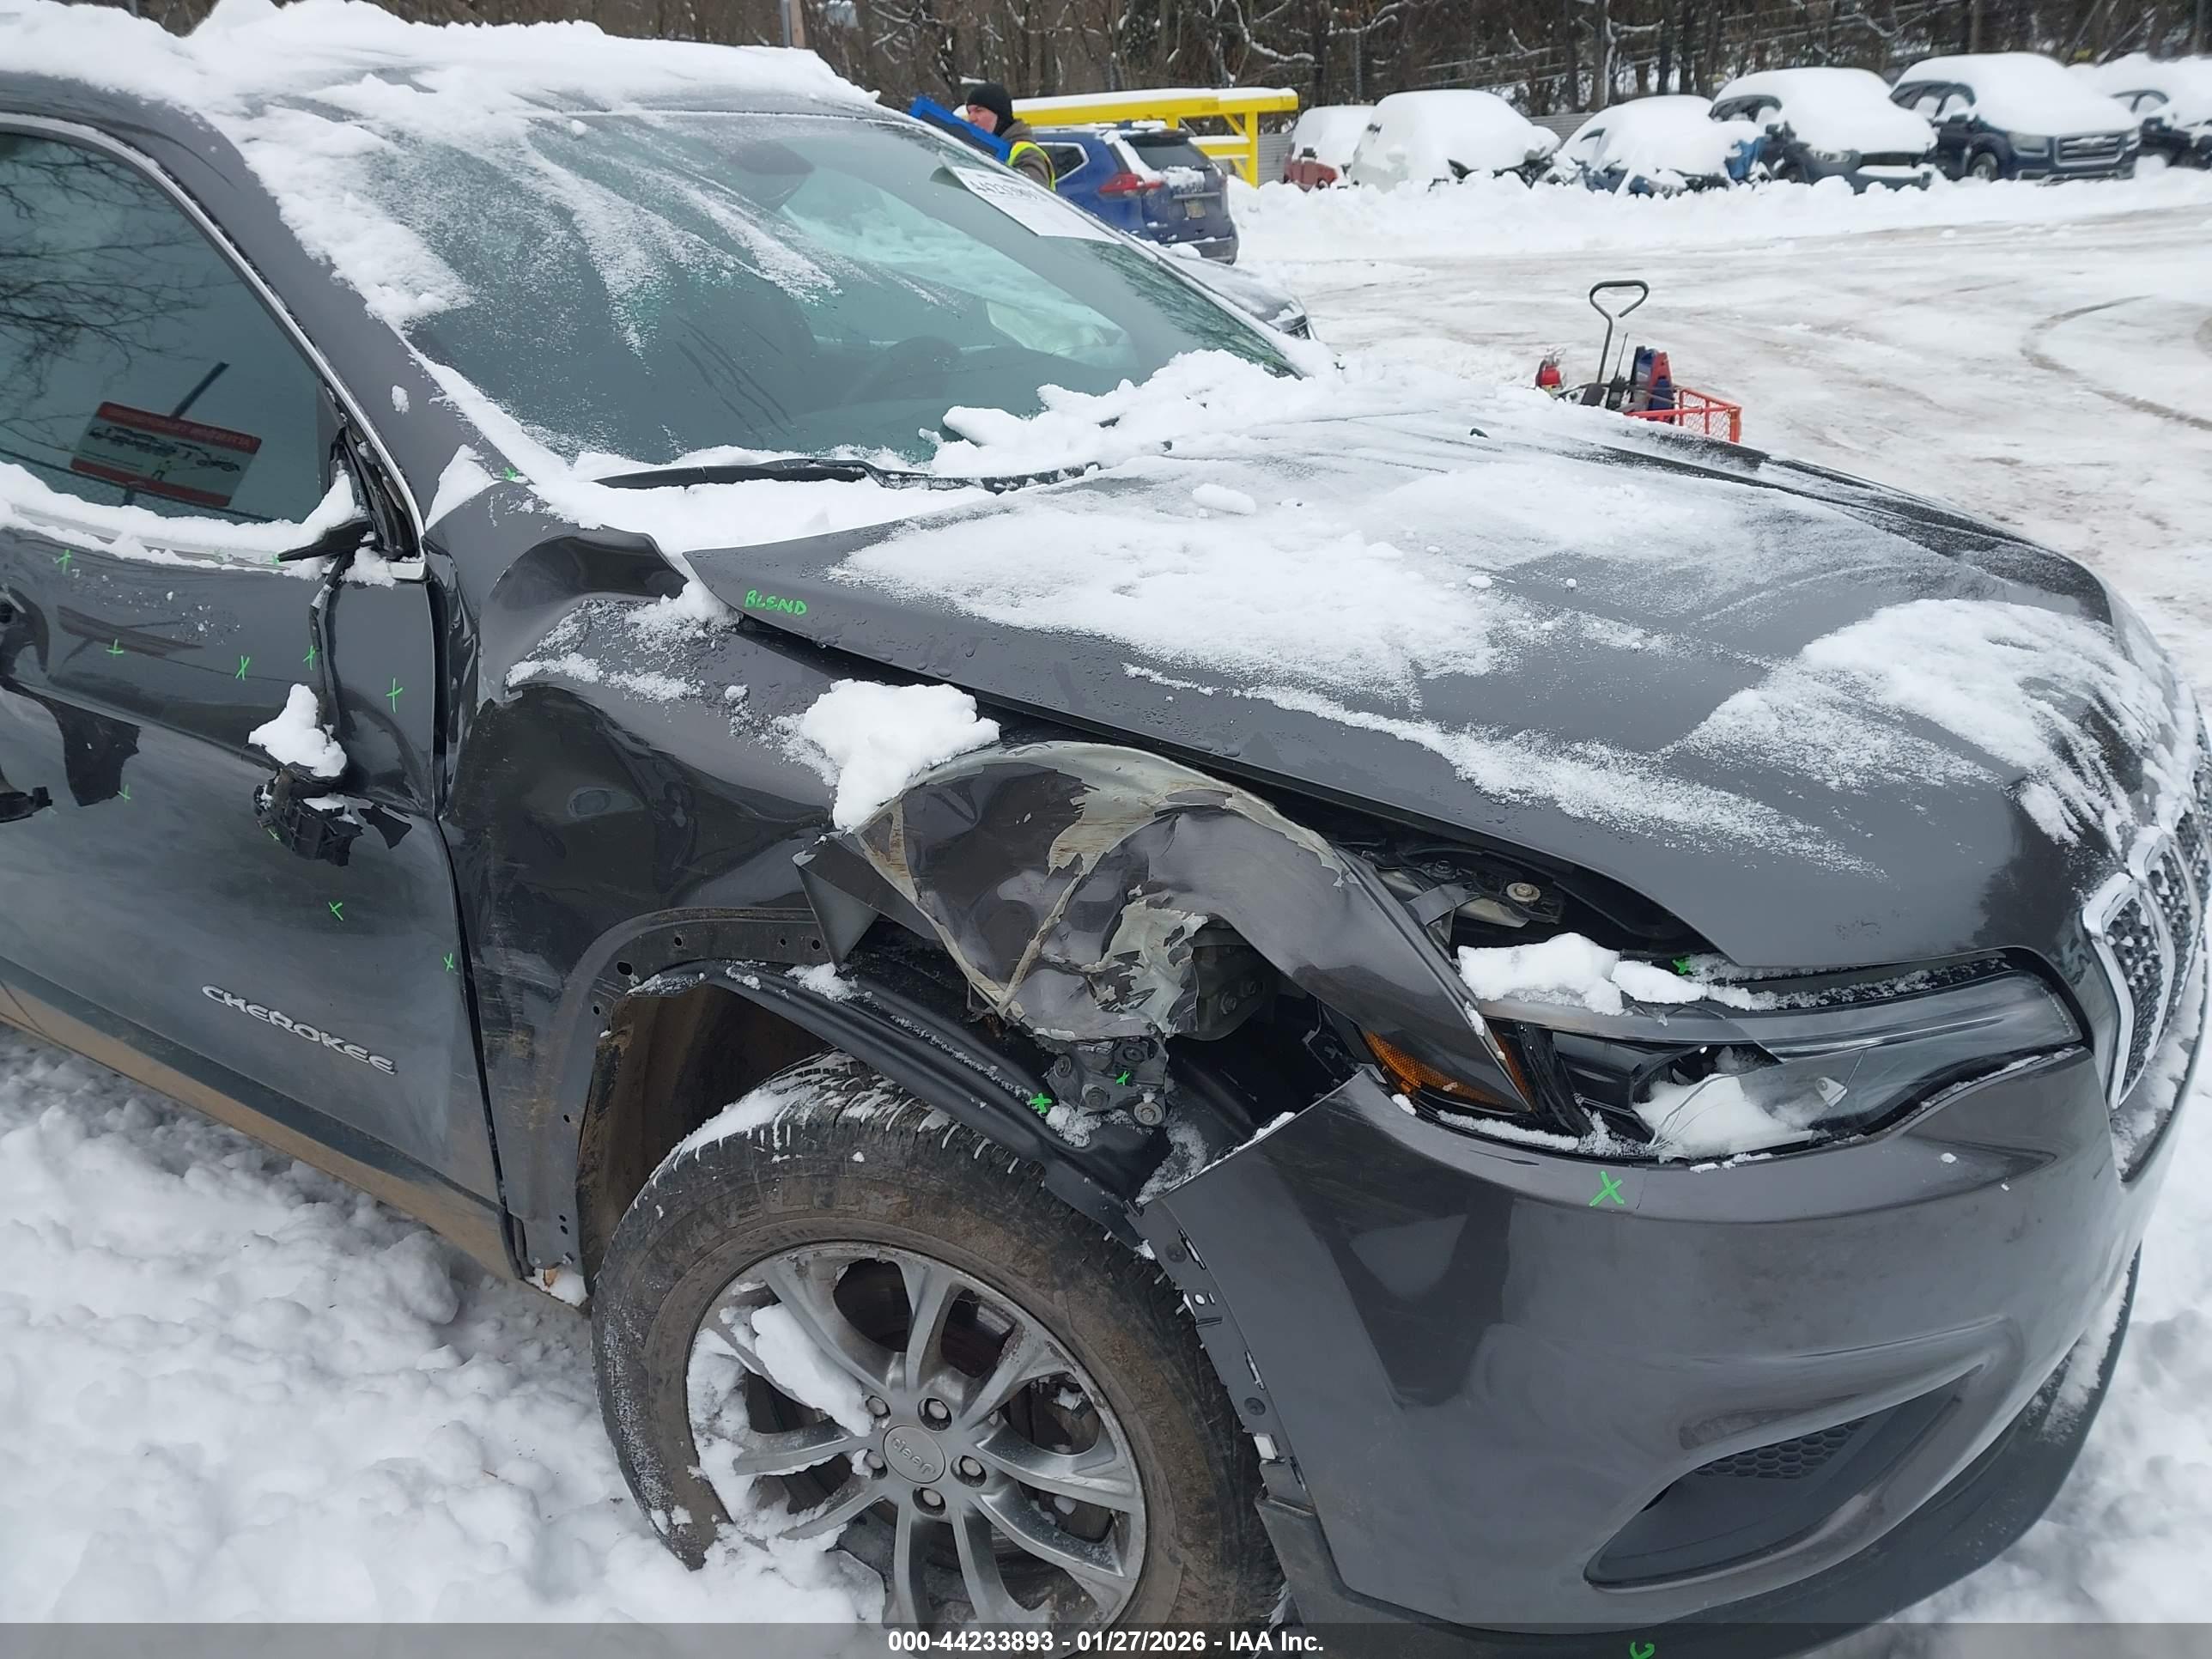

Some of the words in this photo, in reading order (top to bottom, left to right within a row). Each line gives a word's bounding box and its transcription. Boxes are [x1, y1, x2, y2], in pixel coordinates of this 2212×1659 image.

[745, 590, 807, 615] BLEND
[202, 983, 397, 1075] CHEROKEE
[891, 1437, 936, 1474] Jeep
